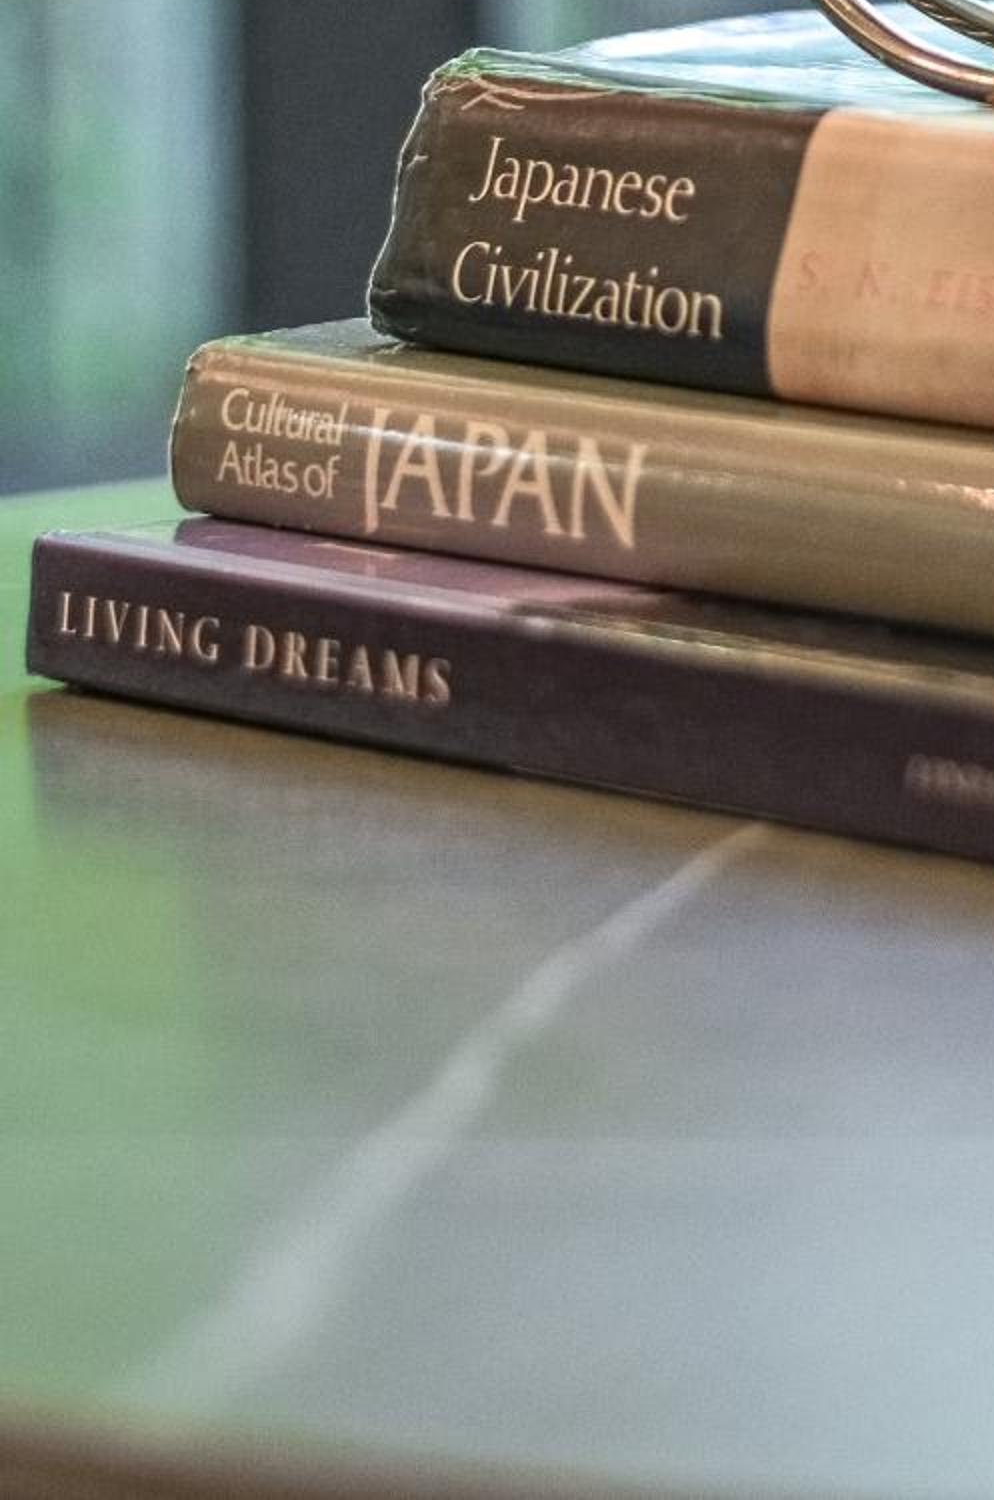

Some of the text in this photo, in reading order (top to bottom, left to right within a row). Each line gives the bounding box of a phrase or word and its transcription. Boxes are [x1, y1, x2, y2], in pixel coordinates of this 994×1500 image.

[469, 137, 695, 223] Japanese
[453, 242, 722, 338] Civilization
[221, 388, 349, 446] Cultural
[217, 442, 341, 498] Atlas of
[364, 407, 647, 548] JAPAN
[60, 592, 452, 706] LIVING DREAMS
